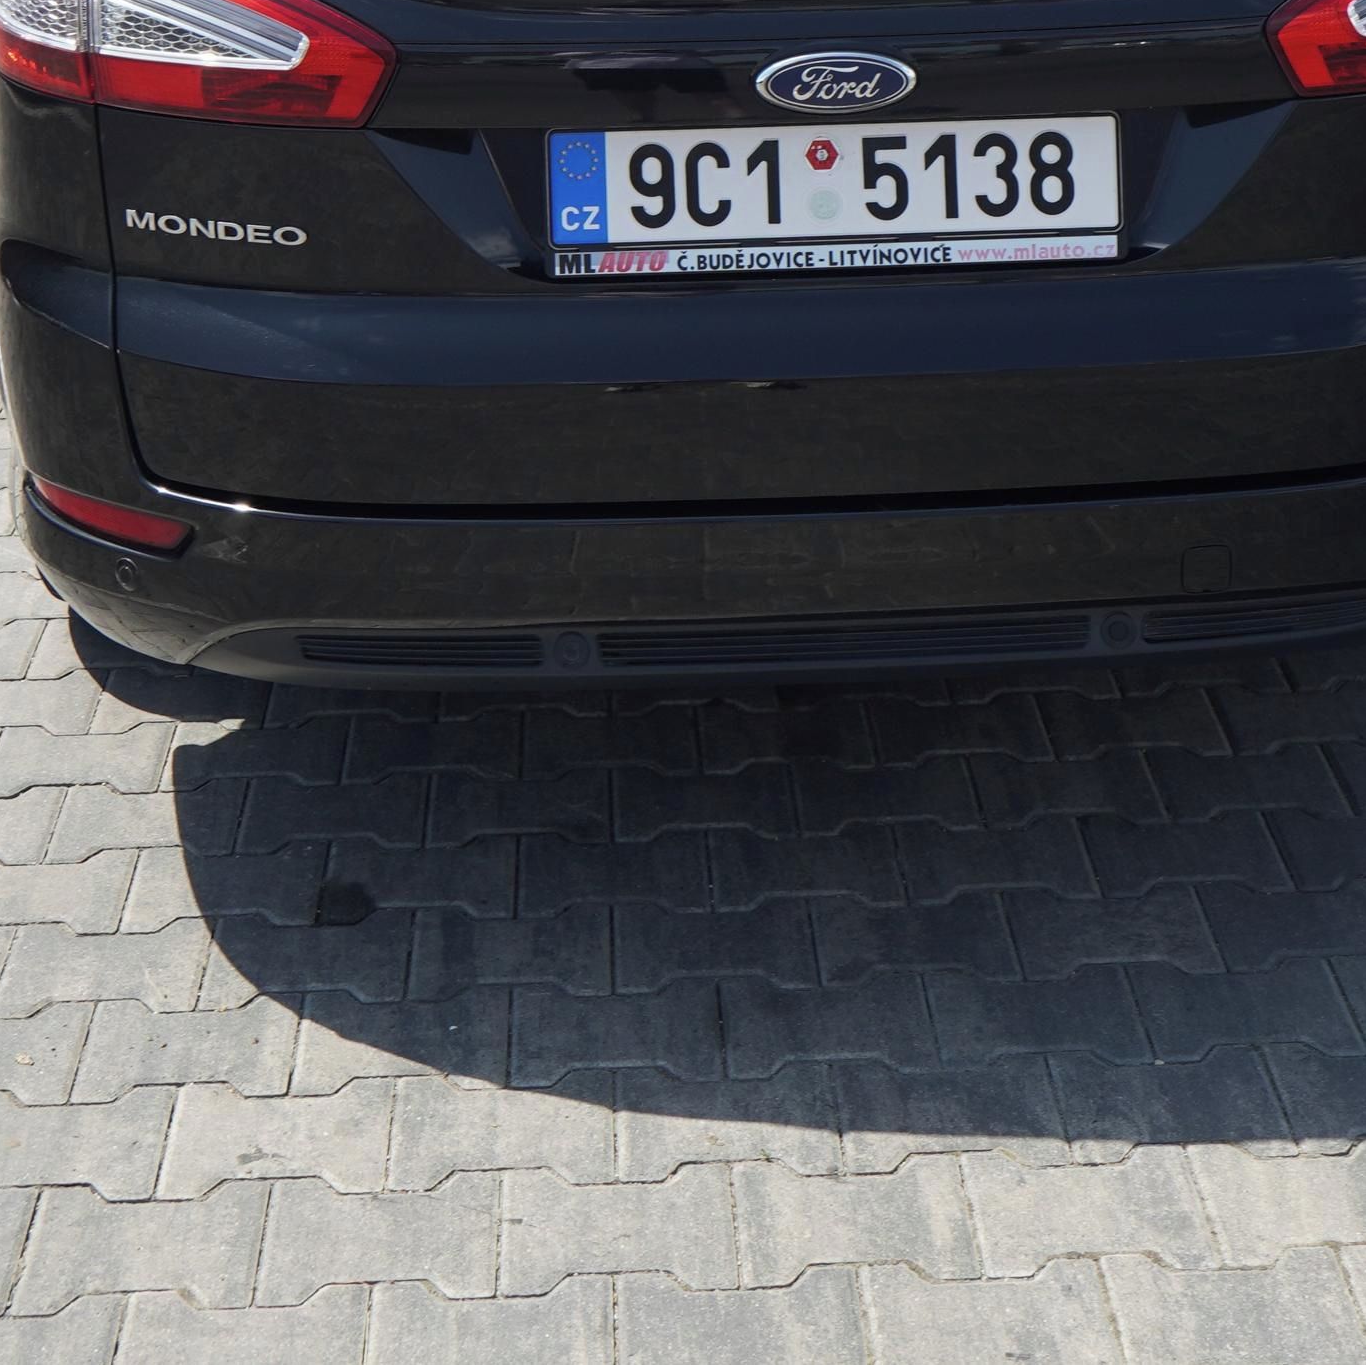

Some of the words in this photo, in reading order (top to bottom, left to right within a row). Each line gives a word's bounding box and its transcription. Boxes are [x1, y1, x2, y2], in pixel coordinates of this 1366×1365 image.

[792, 65, 883, 103] Ford
[629, 139, 784, 229] 9C1
[861, 131, 1074, 221] 5138
[125, 208, 308, 246] MONDEO
[561, 206, 601, 231] CZ
[958, 243, 1116, 261] www.mlauto.cz
